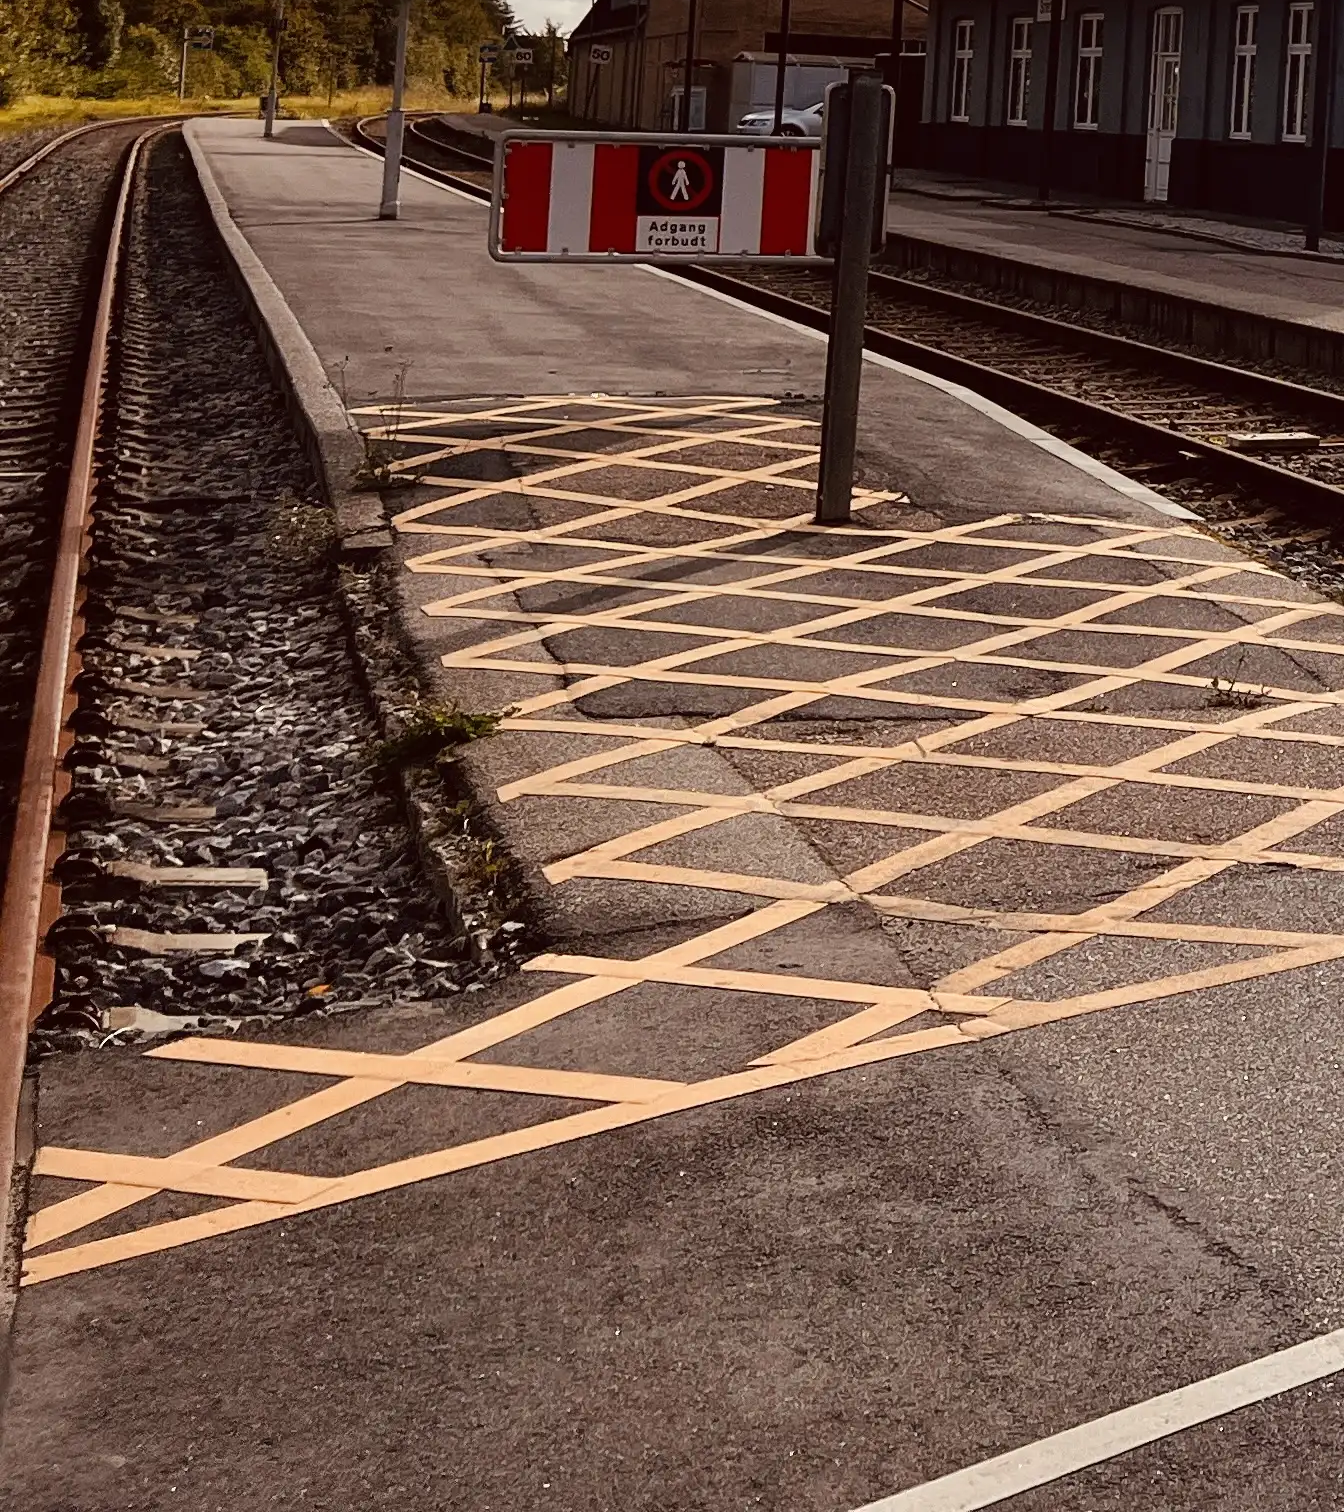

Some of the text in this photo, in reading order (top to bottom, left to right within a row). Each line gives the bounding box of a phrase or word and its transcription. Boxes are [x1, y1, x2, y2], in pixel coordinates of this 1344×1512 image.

[591, 48, 611, 62] 50
[649, 221, 706, 234] Adgang
[648, 235, 706, 247] forbudt
